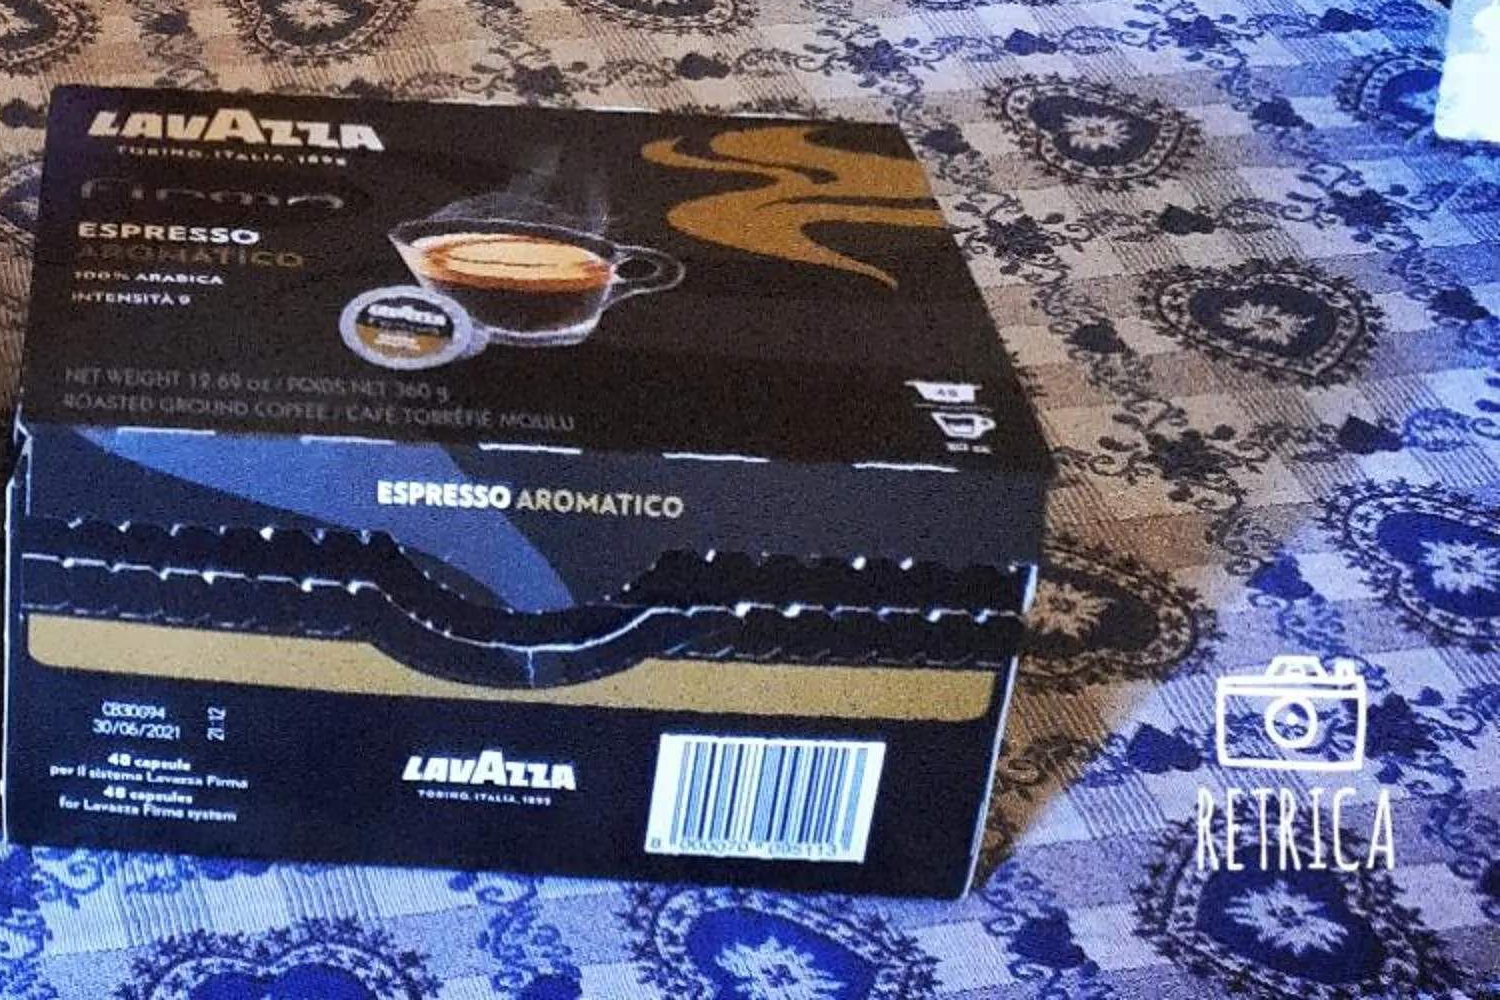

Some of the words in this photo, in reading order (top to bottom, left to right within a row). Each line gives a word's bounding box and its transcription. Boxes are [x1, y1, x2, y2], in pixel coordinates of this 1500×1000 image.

[87, 107, 385, 152] LAVAZZA
[77, 221, 261, 245] ESPRESSO
[75, 243, 304, 269] AROMATICO
[73, 270, 131, 283] 100%
[134, 271, 225, 286] ARABICA
[65, 368, 100, 385] NET
[106, 368, 181, 388] WEIGHT
[351, 379, 386, 398] NET
[63, 393, 153, 412] ROASTED
[159, 396, 249, 417] GROUND
[254, 402, 331, 420] COFFEE
[500, 411, 575, 432] MOULU
[377, 480, 511, 510] ESPRESSO
[516, 489, 683, 518] AROMATICO
[92, 719, 181, 740] 30/06/2021
[107, 752, 131, 767] 48
[133, 757, 191, 772] capsule
[402, 750, 577, 791] LAVAZZA
[50, 764, 74, 777] per
[77, 764, 87, 777] il
[89, 767, 143, 782] sistema
[147, 771, 203, 787] Lavazza
[207, 775, 249, 789] Firma
[103, 785, 126, 799] 48
[129, 790, 193, 805] capsules
[59, 795, 80, 809] for
[84, 799, 139, 815] Lavazza
[143, 803, 184, 818] Firma
[188, 808, 237, 822] system
